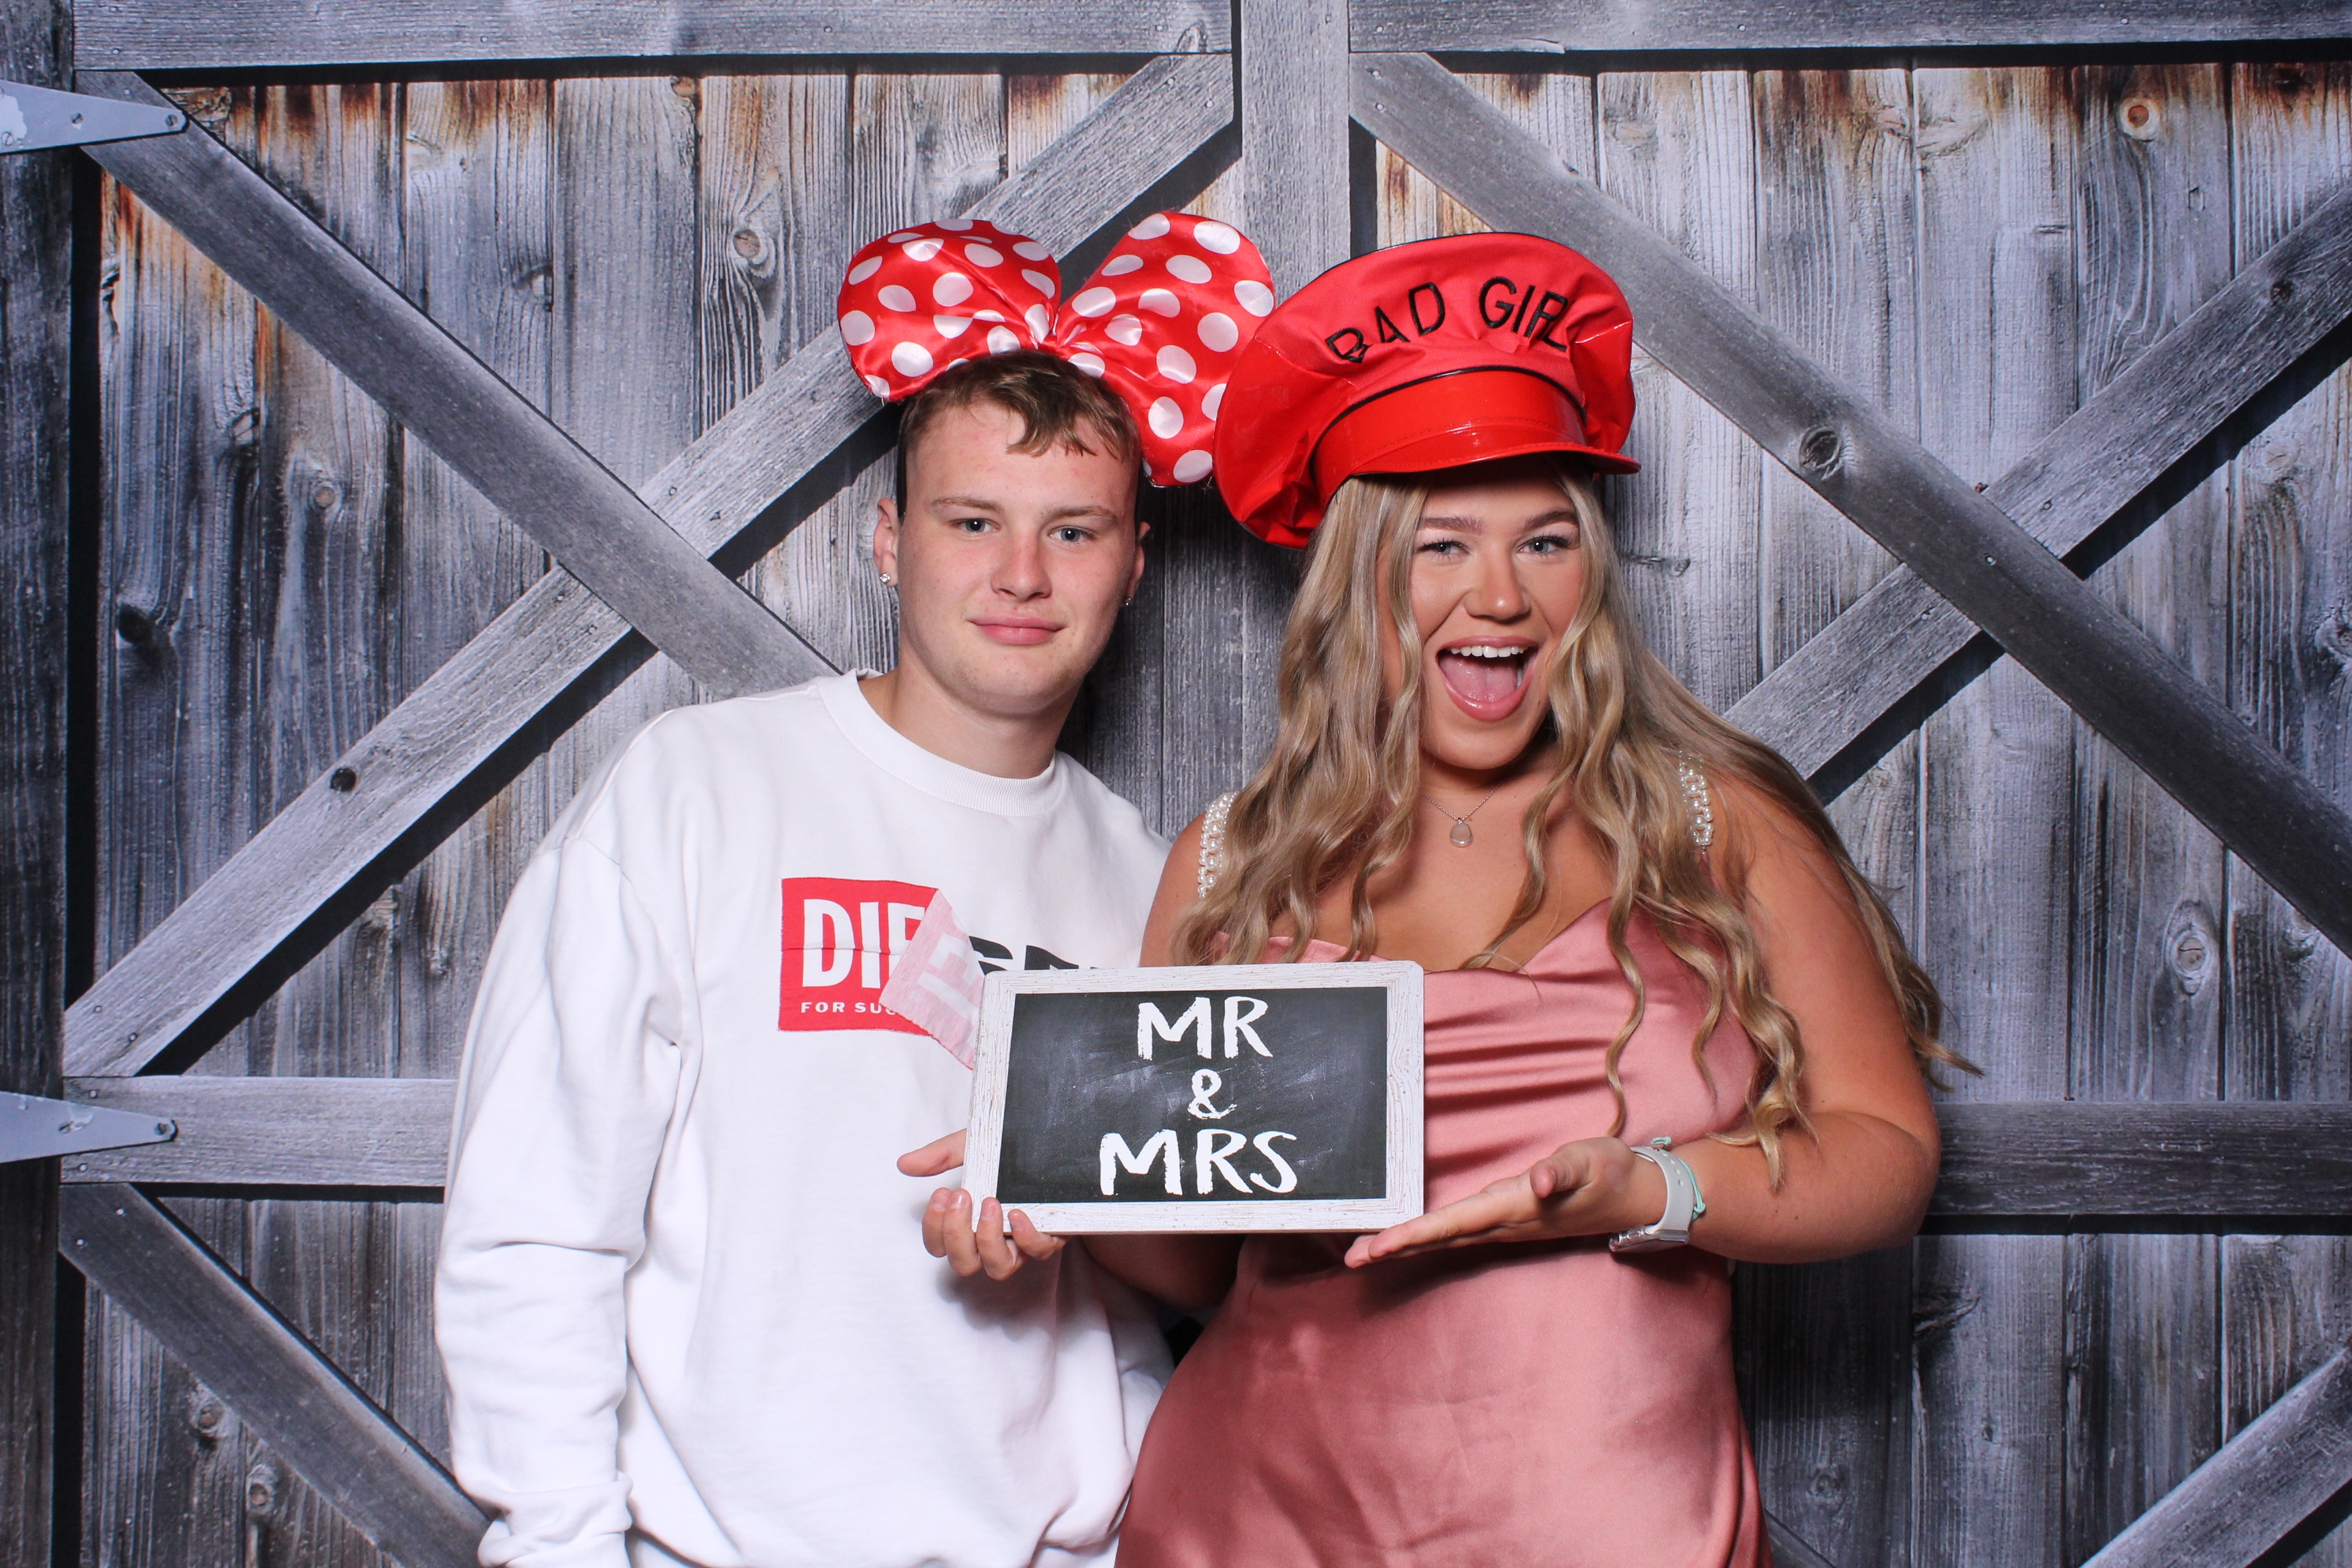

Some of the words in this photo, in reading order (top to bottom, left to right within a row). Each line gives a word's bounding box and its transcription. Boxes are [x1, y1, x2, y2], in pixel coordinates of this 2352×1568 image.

[1324, 281, 1446, 364] BAD
[800, 1001, 846, 1014] FOR
[1137, 996, 1274, 1062] MR
[1187, 1068, 1238, 1120] &
[1099, 1128, 1298, 1196] MRS
